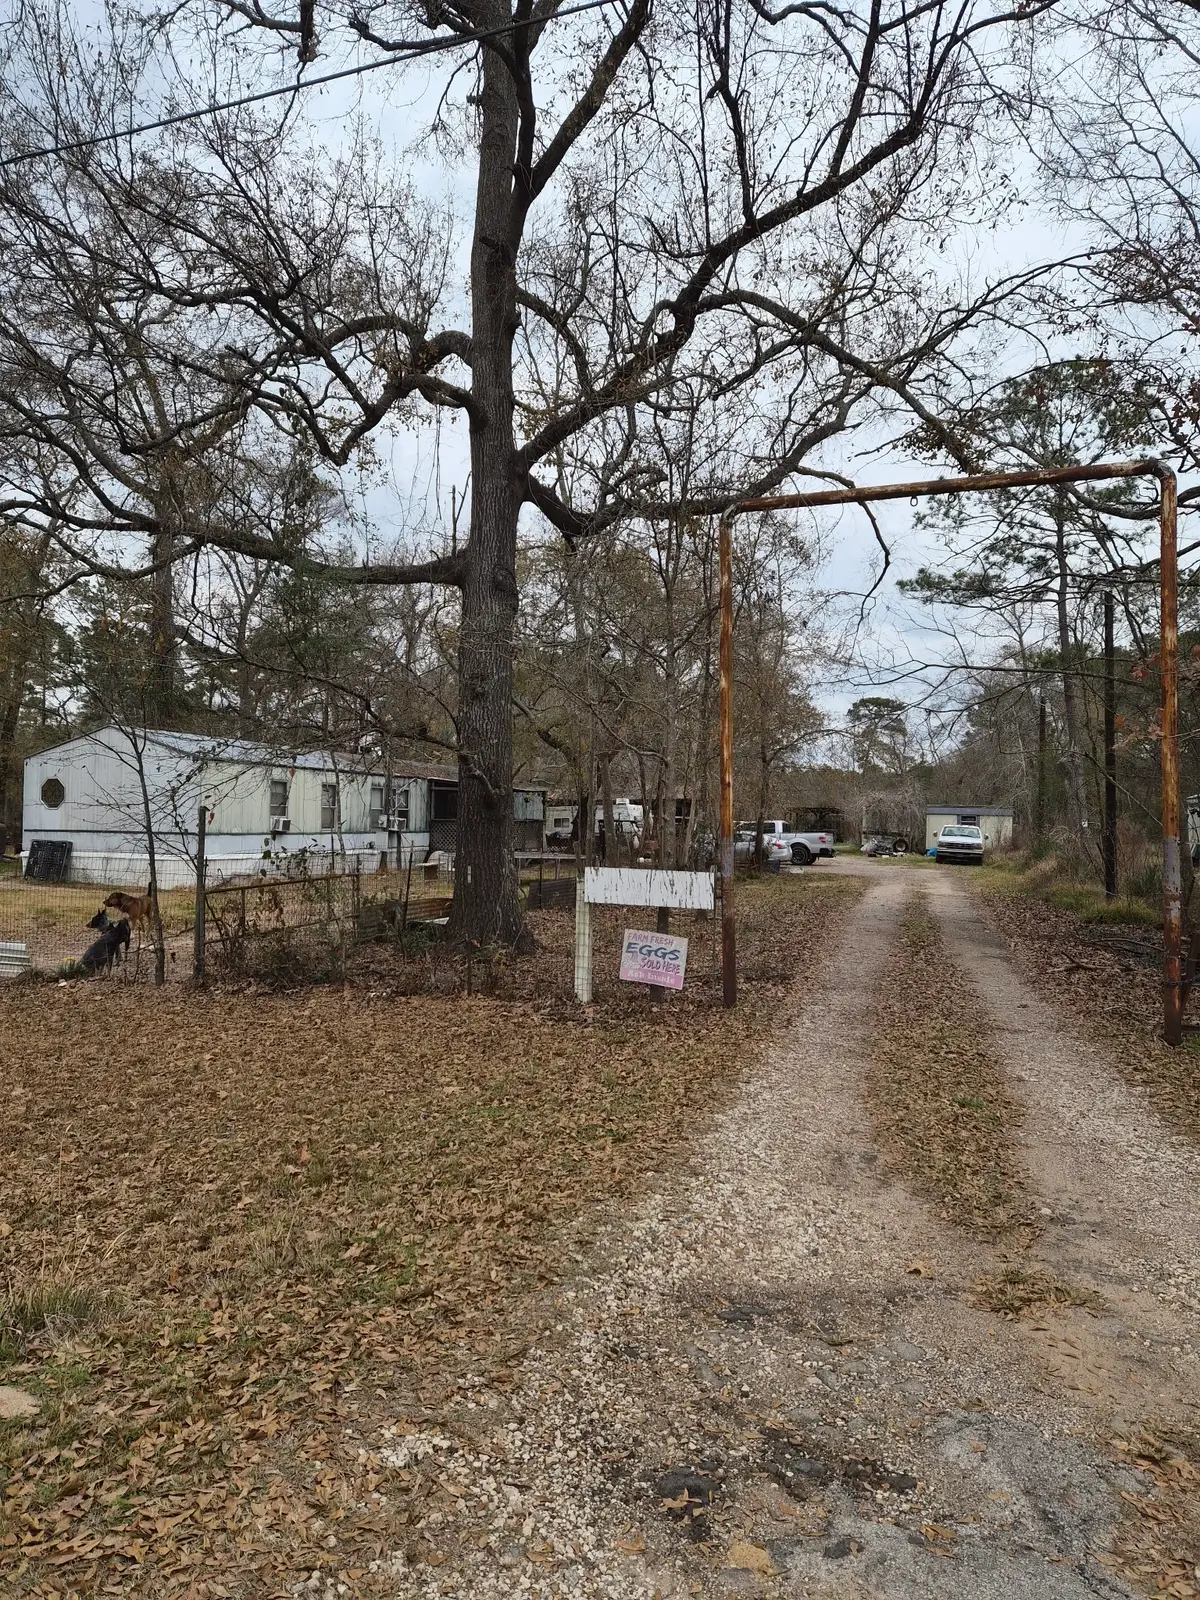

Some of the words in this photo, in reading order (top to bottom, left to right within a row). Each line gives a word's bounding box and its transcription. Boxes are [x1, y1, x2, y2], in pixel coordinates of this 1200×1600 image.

[628, 932, 649, 943] FARM
[650, 935, 674, 946] FRESH
[625, 941, 681, 961] EGGS
[641, 957, 661, 970] SOLD
[663, 960, 681, 975] HERE
